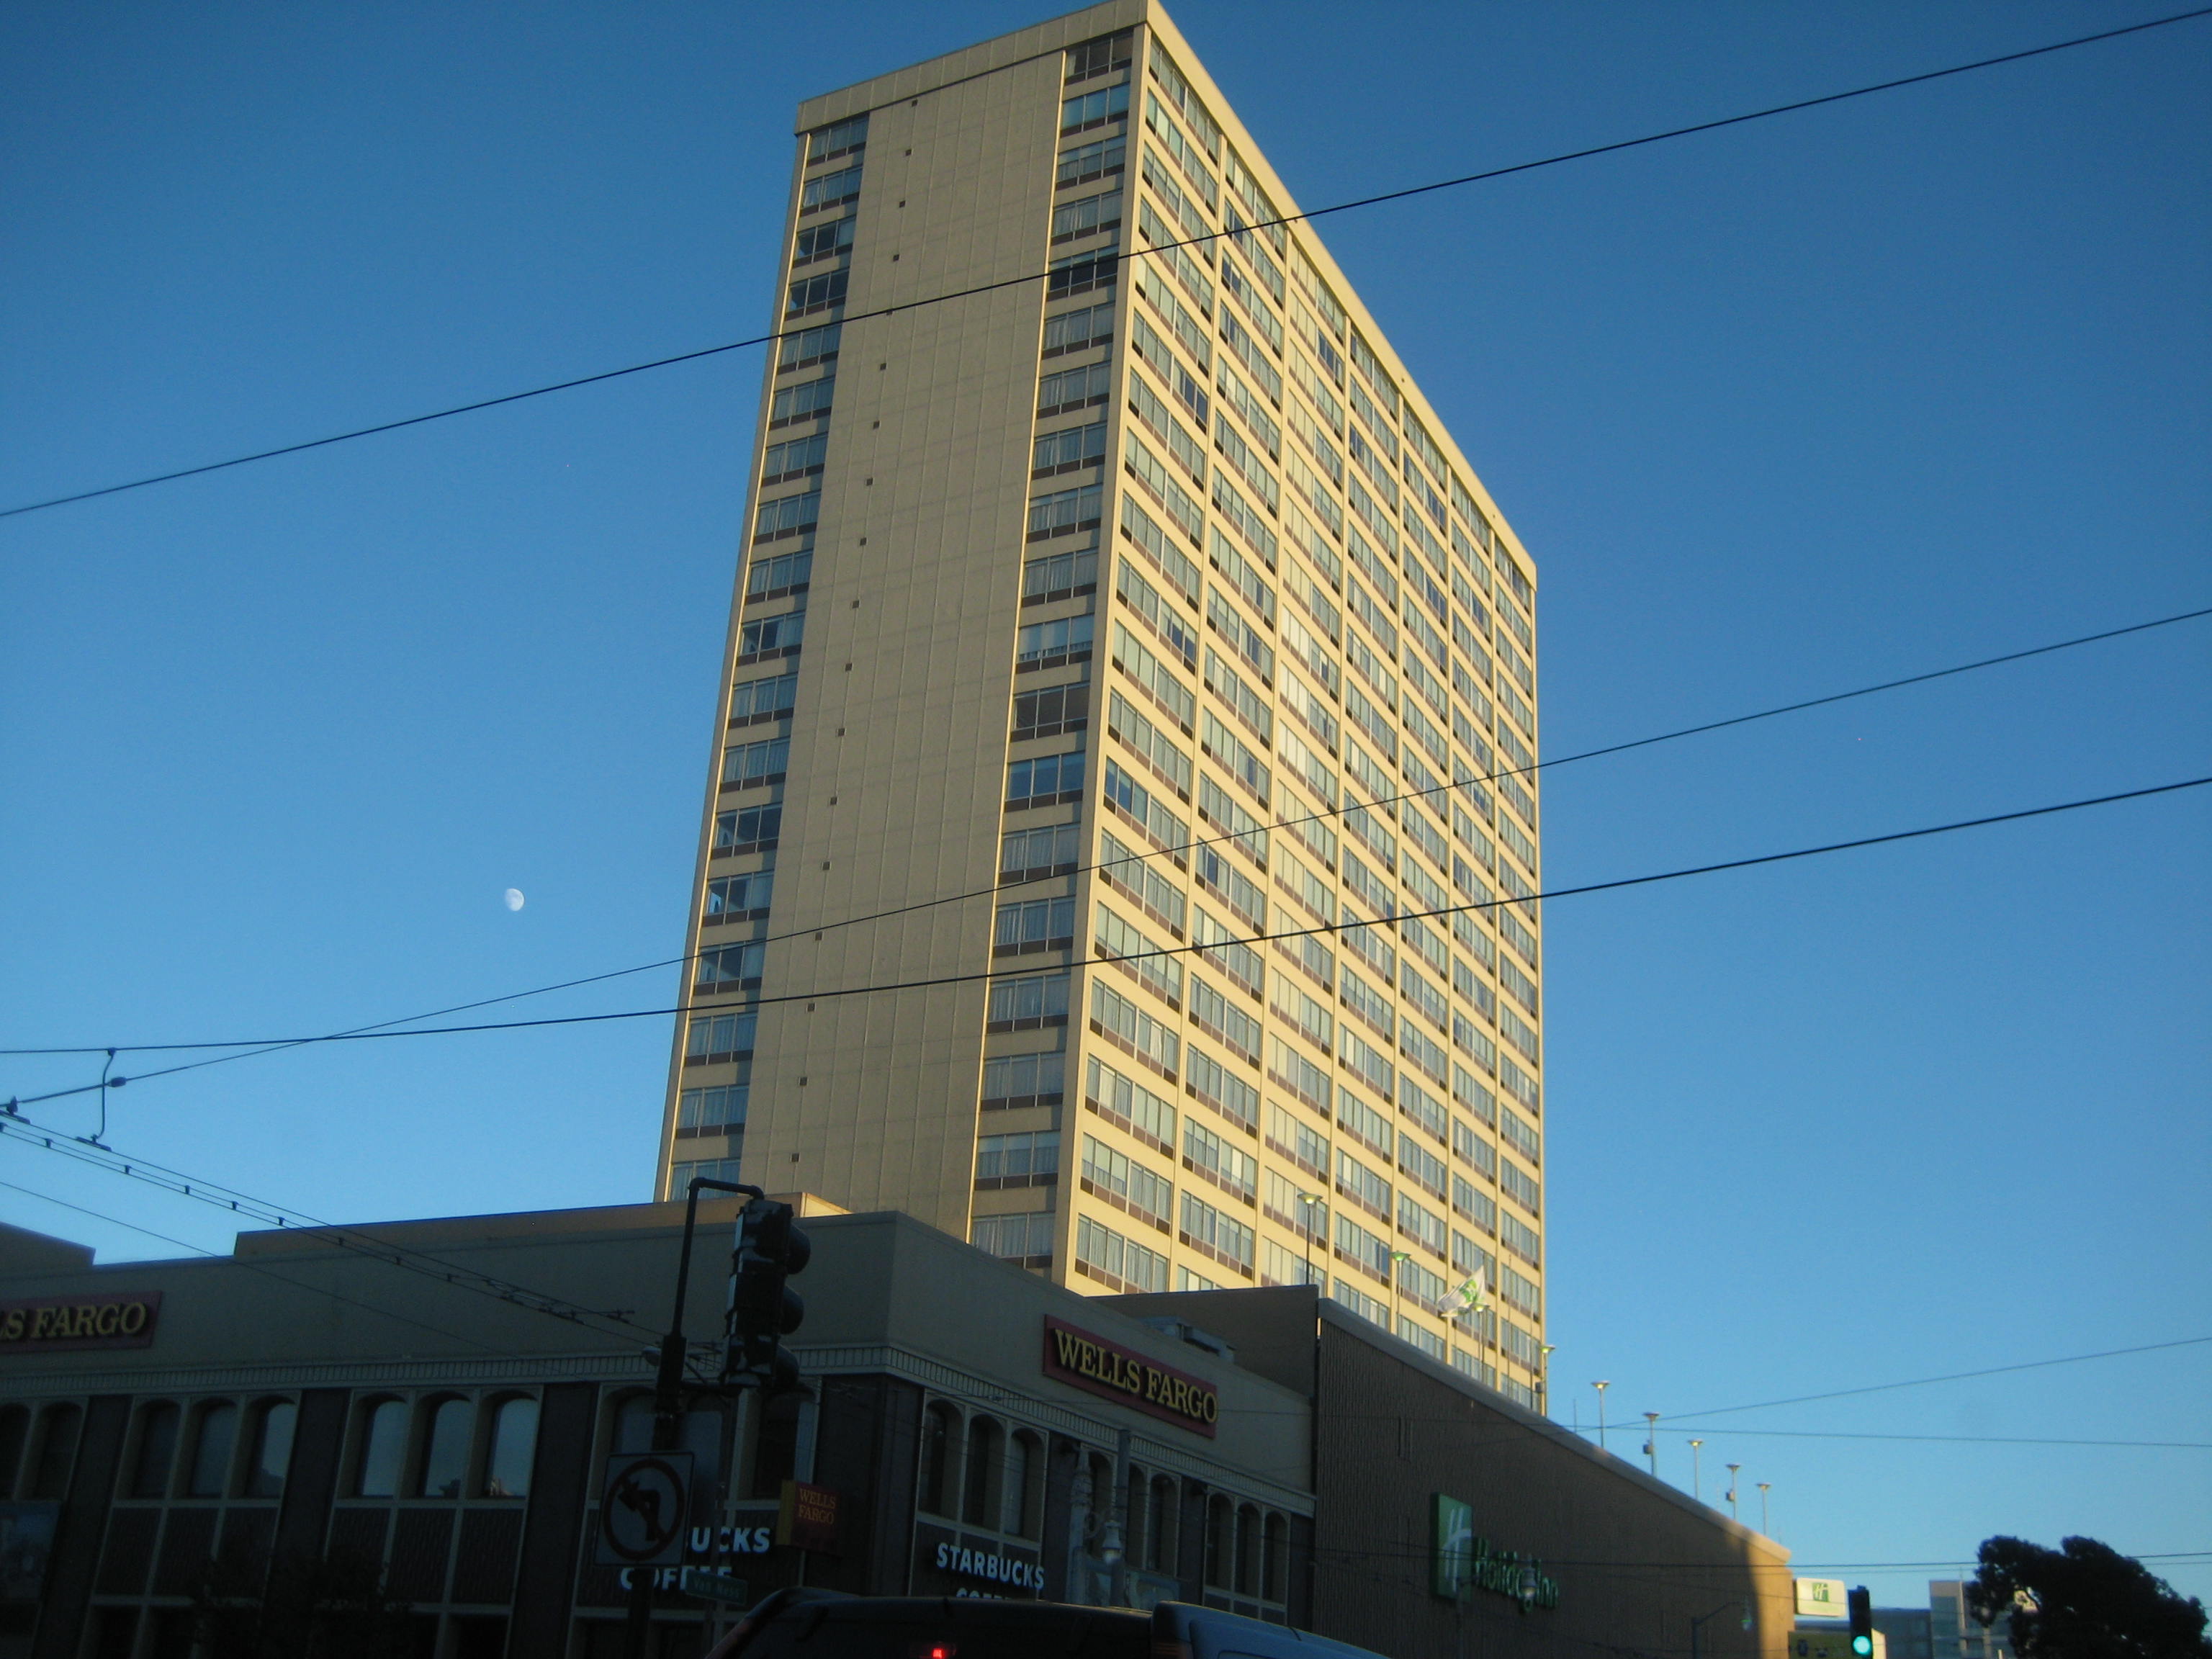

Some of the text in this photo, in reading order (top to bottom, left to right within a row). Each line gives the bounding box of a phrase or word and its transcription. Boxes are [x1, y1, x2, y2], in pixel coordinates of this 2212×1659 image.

[30, 1302, 148, 1338] FARGO
[1054, 1328, 1218, 1424] WELLS FARGO
[799, 1488, 836, 1510] WELLS
[799, 1504, 835, 1525] FARGO
[936, 1542, 1045, 1590] STARBUCKS
